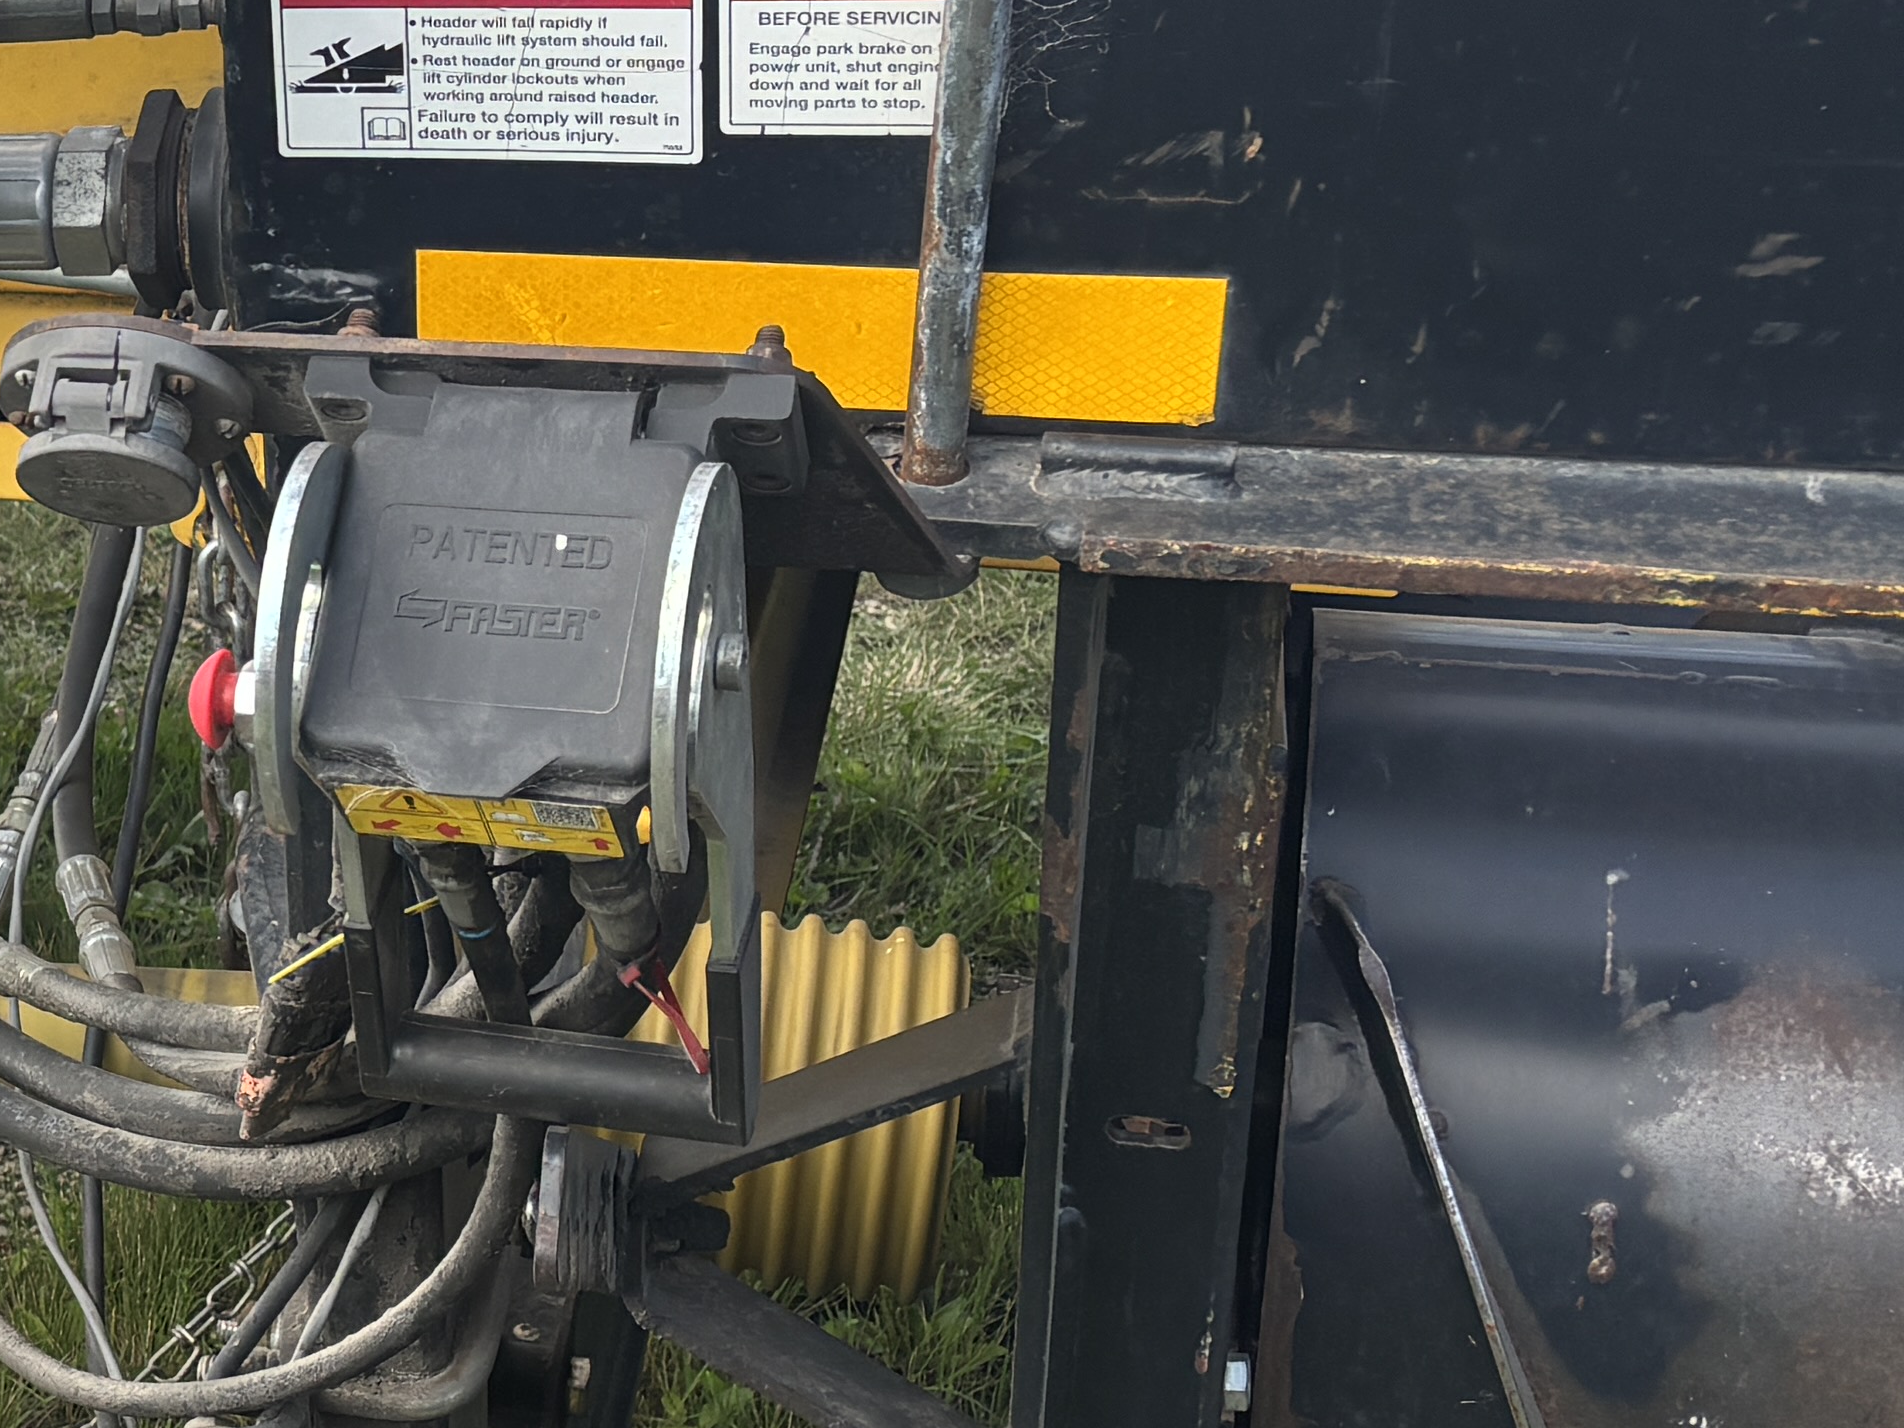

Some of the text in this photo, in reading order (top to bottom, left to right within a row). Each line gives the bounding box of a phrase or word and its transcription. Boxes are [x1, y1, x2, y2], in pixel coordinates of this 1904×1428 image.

[421, 17, 607, 32] Header will fall rapidly if
[758, 11, 942, 26] BEFORE SERVICIN
[422, 34, 668, 50] hydraulic lift system should fail.
[749, 41, 932, 57] Engage park brake on
[422, 54, 685, 72] Rest header on ground or engage
[749, 60, 882, 76] power unit, shut
[422, 73, 625, 88] lift cylinder lockouts when
[749, 78, 922, 92] down and wait for all
[423, 89, 659, 105] working around raised header.
[749, 96, 926, 112] moving parts to stop.
[418, 110, 679, 128] Failure to comply will result in
[418, 128, 619, 144] death or serious injury.
[409, 524, 614, 570] PATENTED
